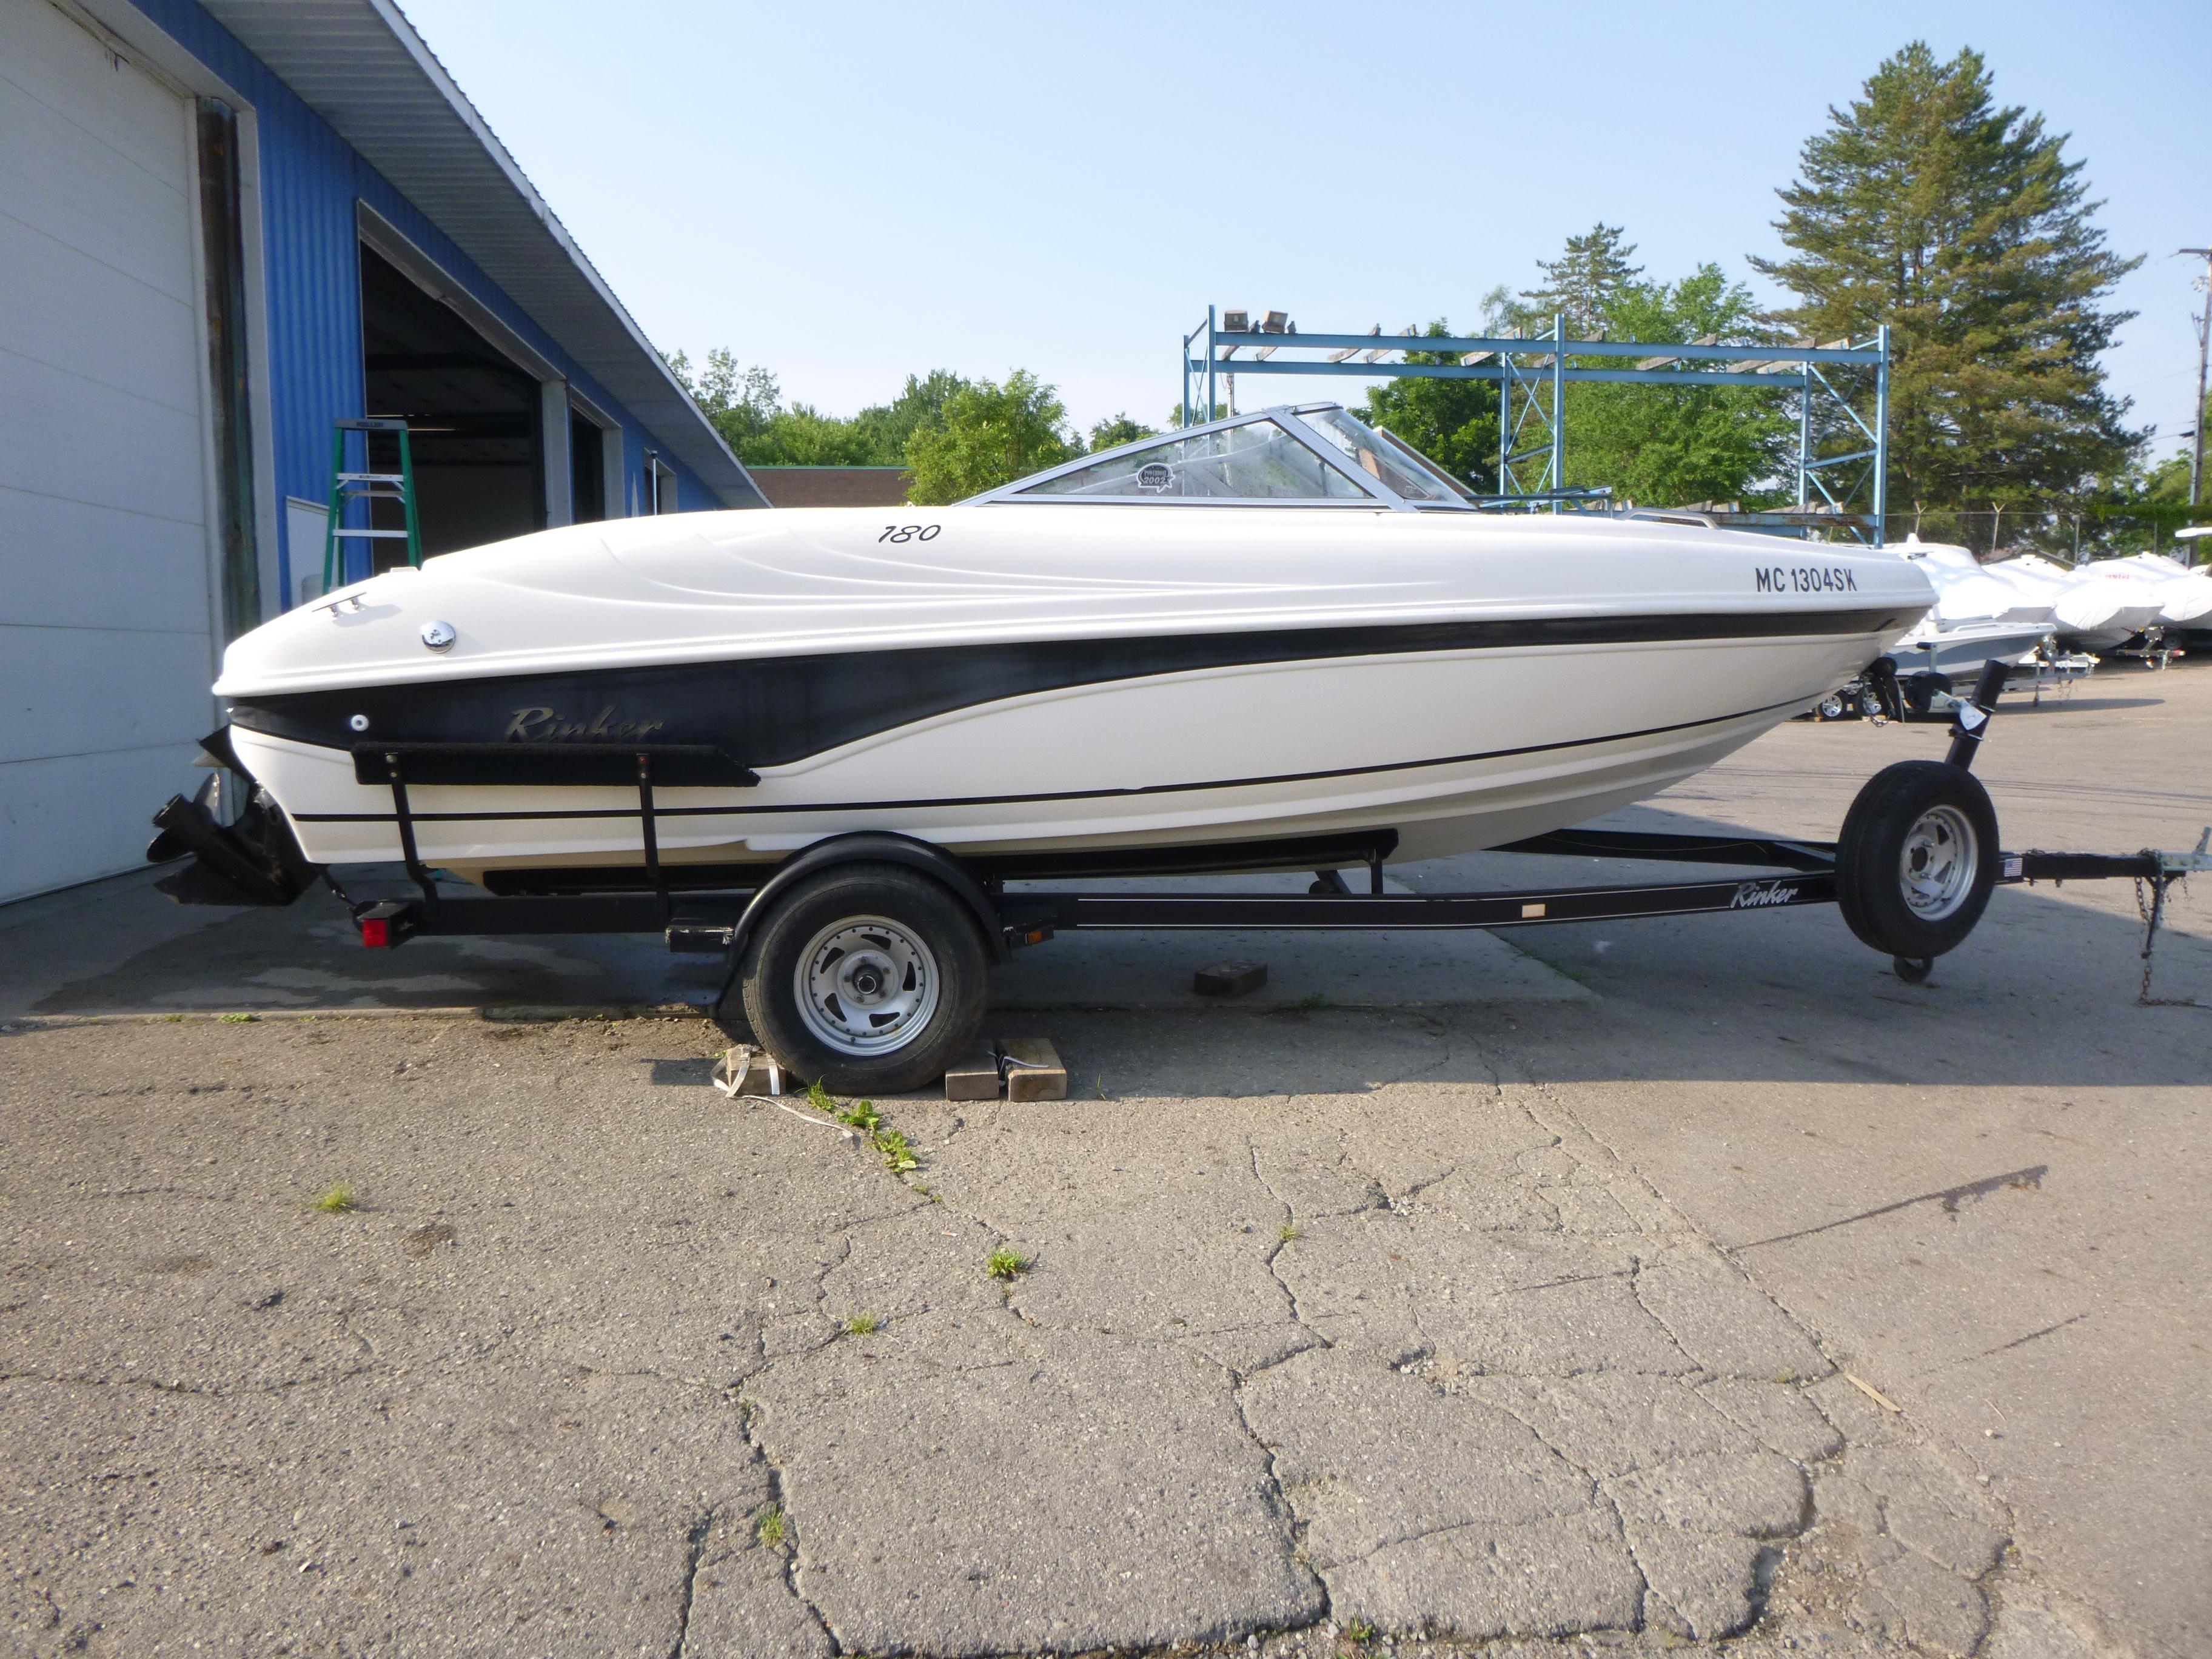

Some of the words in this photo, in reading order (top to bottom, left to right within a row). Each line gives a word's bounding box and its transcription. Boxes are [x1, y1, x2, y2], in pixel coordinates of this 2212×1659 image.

[878, 525, 941, 543] 180
[1755, 568, 1785, 592] MC
[506, 705, 666, 743] Rinker
[1730, 880, 1799, 908] Rinker
